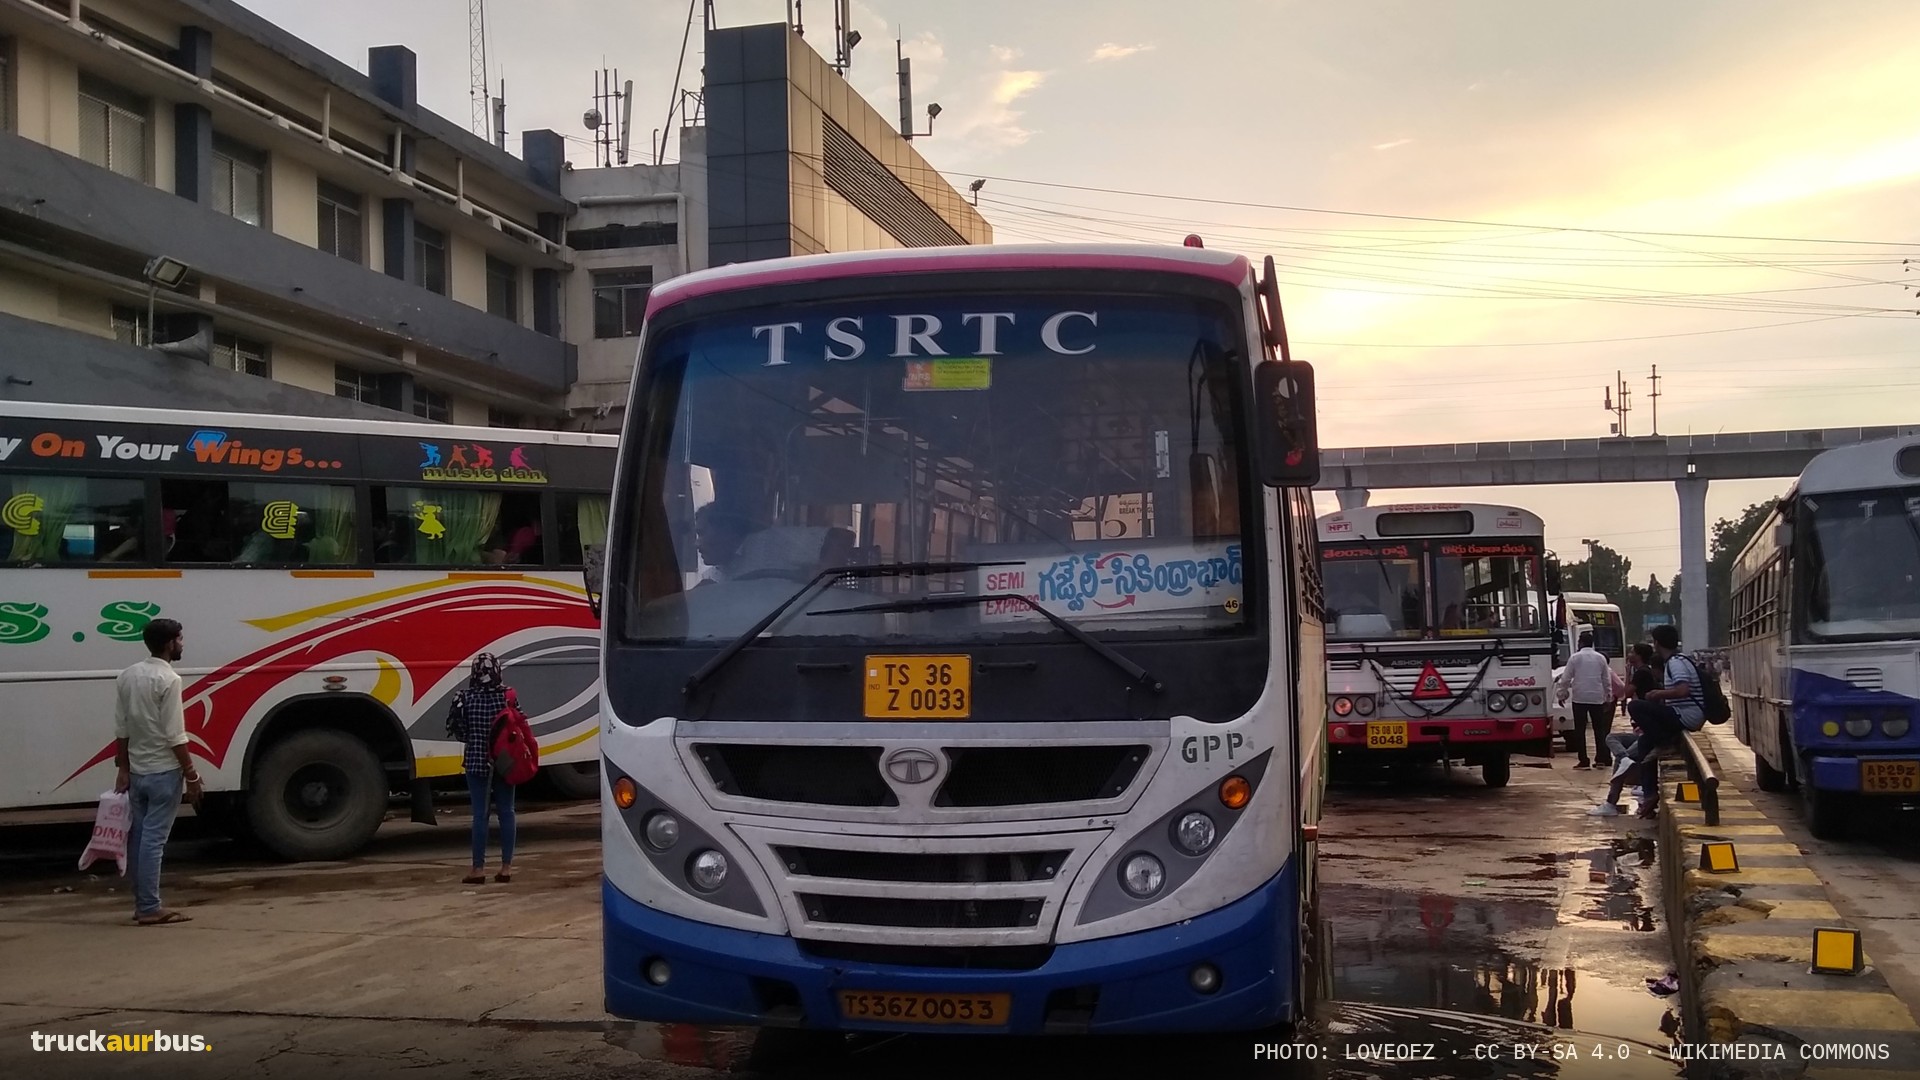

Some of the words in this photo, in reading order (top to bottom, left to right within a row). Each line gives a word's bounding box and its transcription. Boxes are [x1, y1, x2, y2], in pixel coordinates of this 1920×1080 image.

[31, 432, 86, 458] On
[96, 435, 179, 461] Your
[193, 440, 342, 471] Wings...
[423, 467, 498, 482] music
[500, 467, 547, 483] dan
[986, 571, 1025, 591] SEMI
[1225, 600, 1238, 609] 46
[884, 663, 910, 686] TS
[926, 663, 952, 686] 36
[888, 689, 900, 711] Z
[911, 689, 965, 711] 0033
[1370, 725, 1380, 735] TS
[1382, 725, 1392, 735] 08
[1394, 725, 1404, 735] UD
[1182, 733, 1243, 763] GPP
[1370, 736, 1404, 745] 8048
